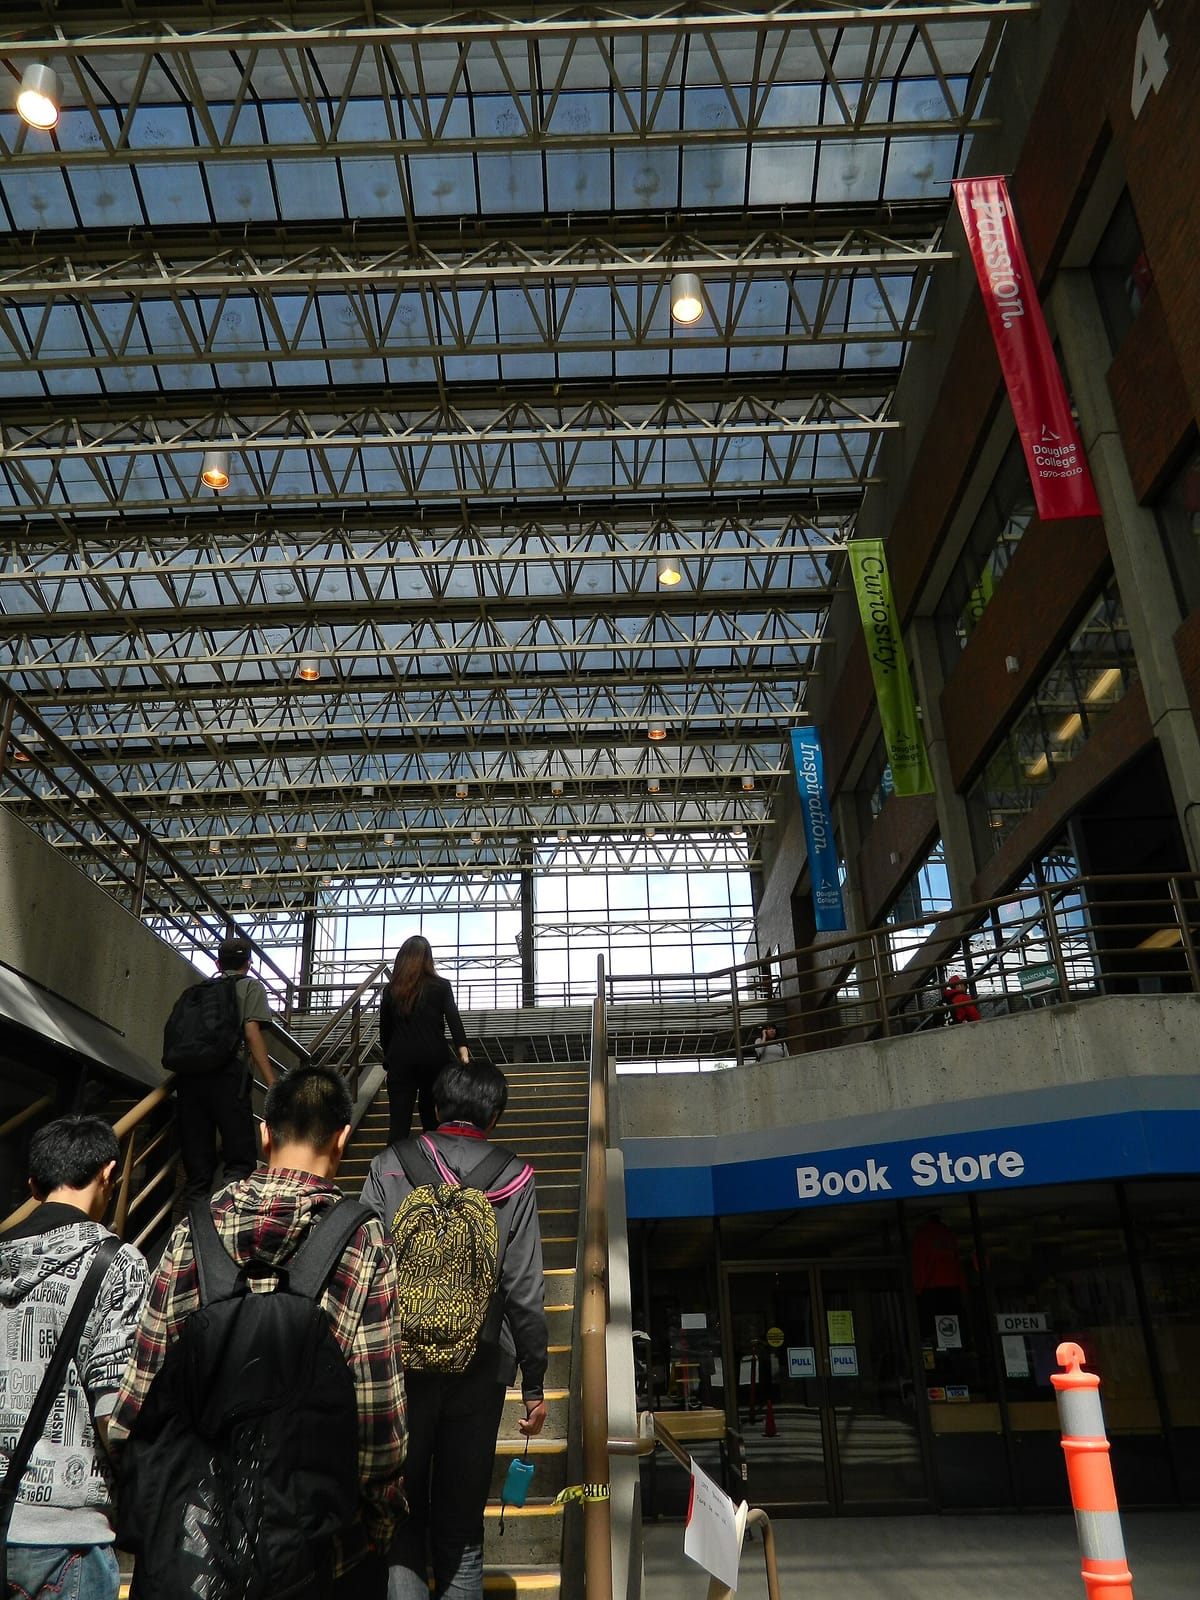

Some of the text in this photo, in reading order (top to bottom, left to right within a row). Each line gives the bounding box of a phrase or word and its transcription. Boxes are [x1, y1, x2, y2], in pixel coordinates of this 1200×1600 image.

[971, 199, 1024, 329] Passion.
[1032, 443, 1077, 458] Douglas
[1036, 456, 1077, 468] College
[1039, 467, 1083, 478] 1970-2010
[861, 556, 898, 674] Curiosity.
[800, 742, 828, 854] Inspiration.
[796, 1151, 1025, 1199] Book Store
[1004, 1317, 1039, 1330] OPEN
[791, 1358, 811, 1366] PULL
[834, 1356, 854, 1365] PULL
